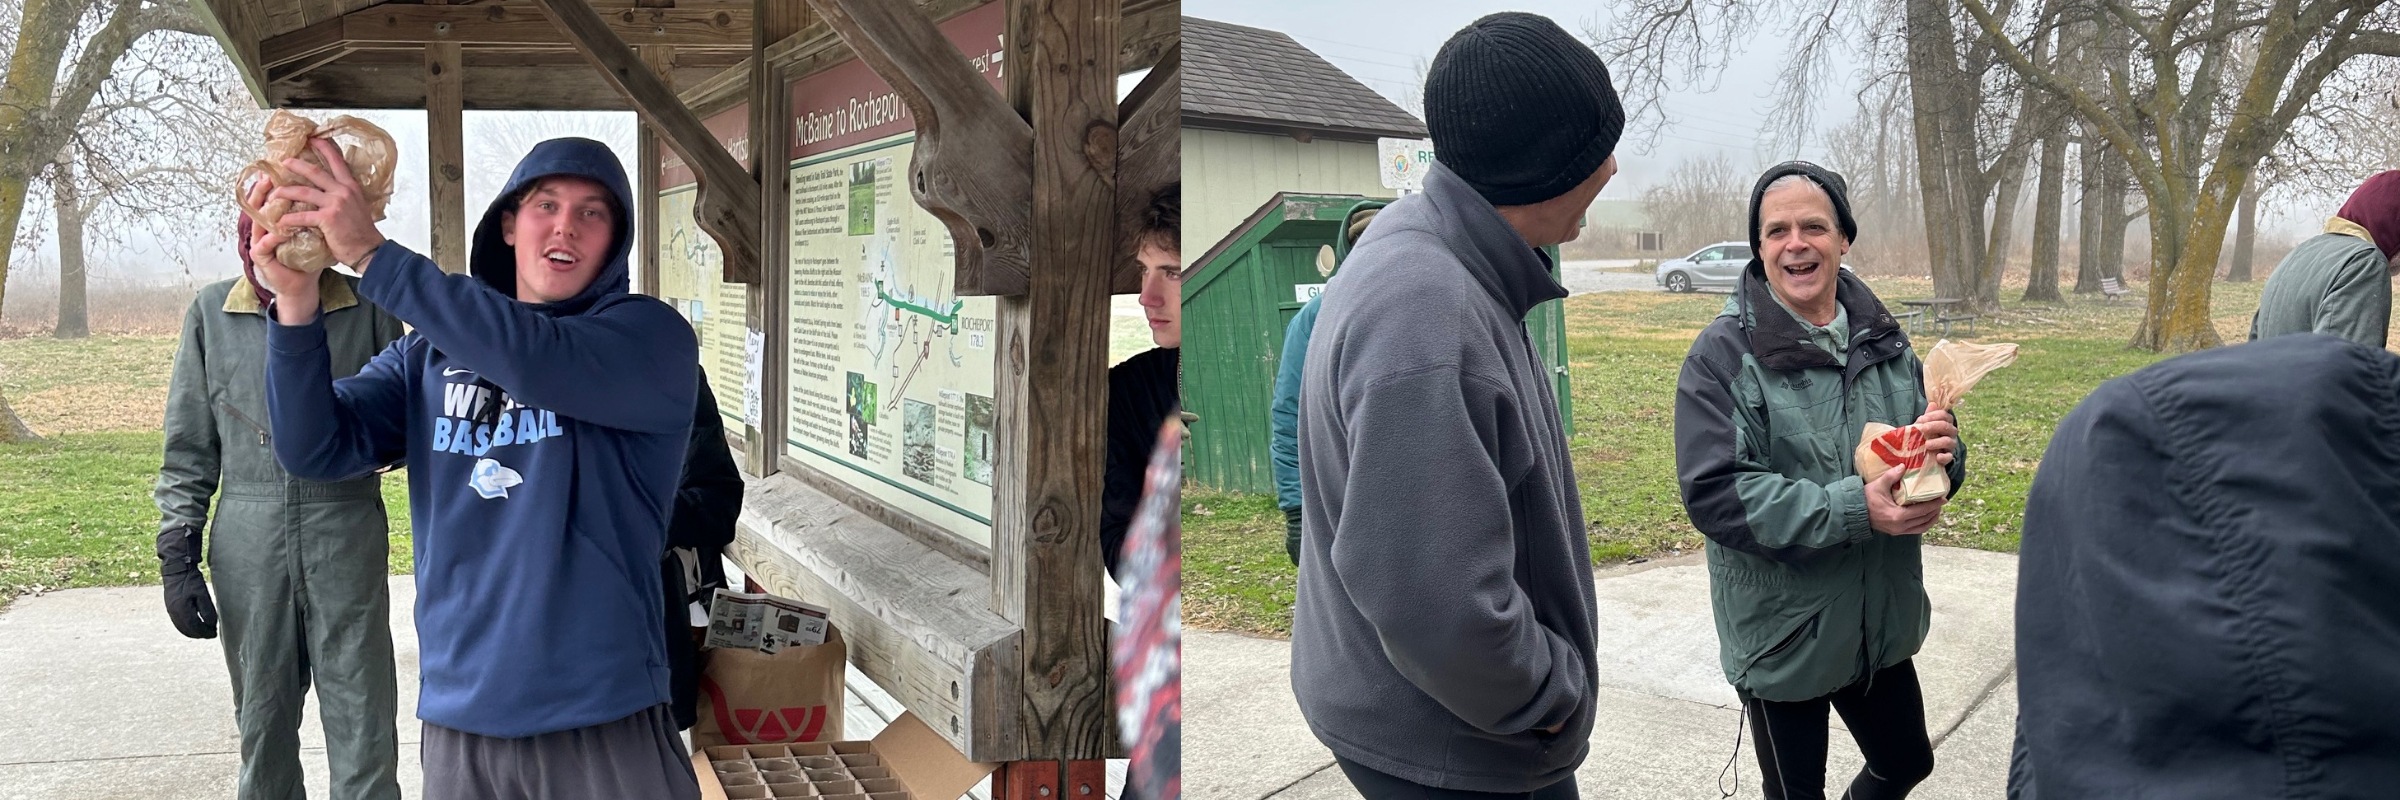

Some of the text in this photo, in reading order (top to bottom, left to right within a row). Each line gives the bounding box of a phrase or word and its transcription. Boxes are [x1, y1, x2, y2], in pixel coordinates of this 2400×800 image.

[970, 48, 990, 73] rest
[795, 110, 833, 147] McBaine
[836, 106, 846, 136] to
[961, 317, 994, 332] ROCHEPORT
[970, 334, 984, 348] 178.3
[432, 408, 564, 457] BASBALL
